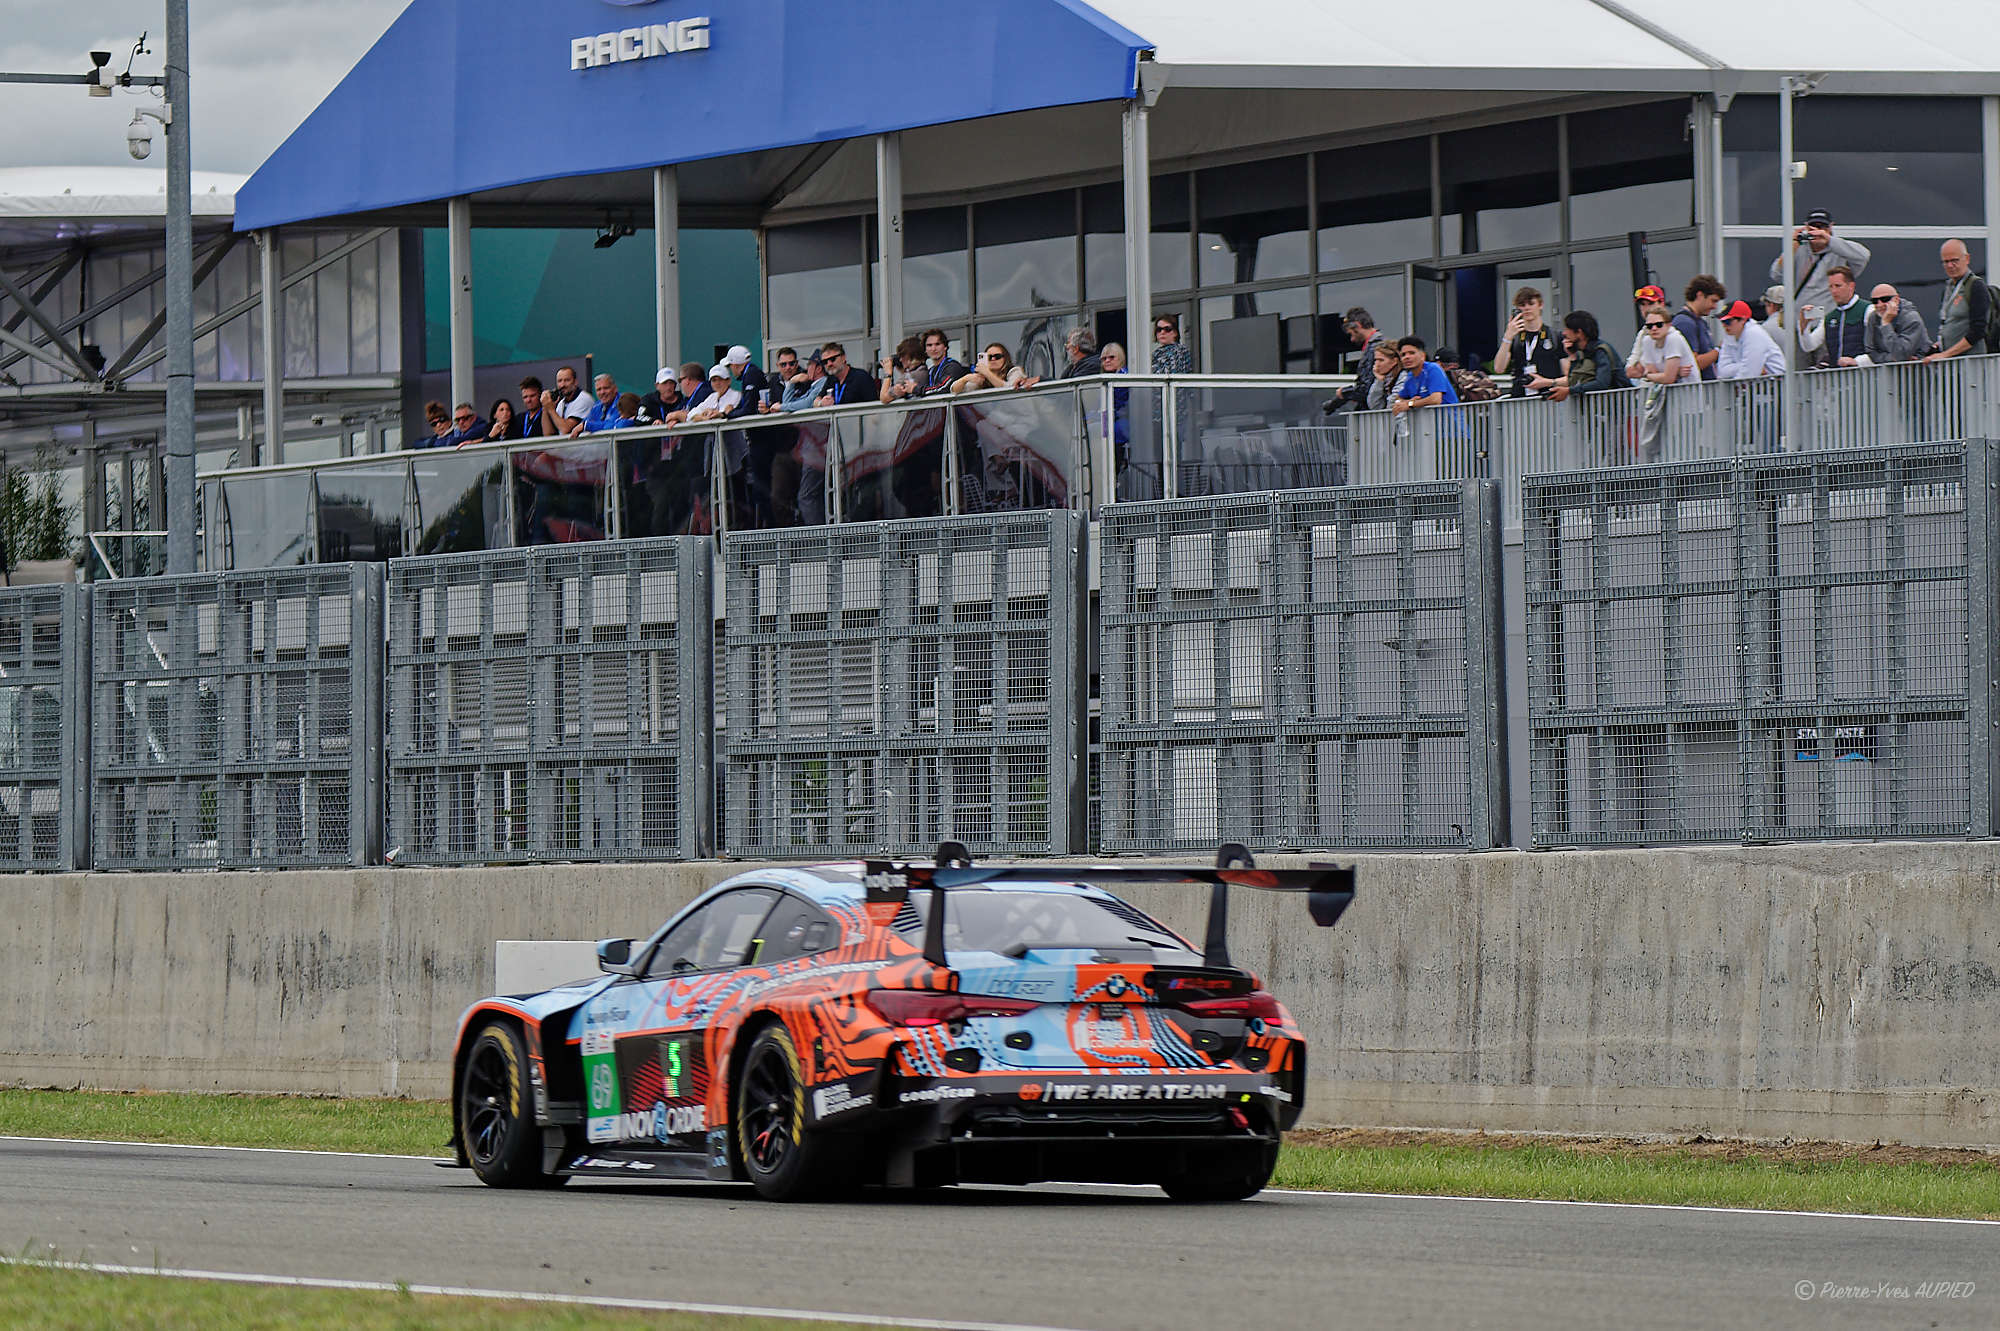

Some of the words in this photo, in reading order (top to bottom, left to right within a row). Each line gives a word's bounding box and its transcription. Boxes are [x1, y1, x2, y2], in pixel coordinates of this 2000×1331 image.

[571, 17, 709, 70] RACING
[592, 1064, 614, 1109] 69
[1092, 1084, 1143, 1100] ARE
[1144, 1084, 1162, 1099] A
[1163, 1084, 1226, 1100] TEAM
